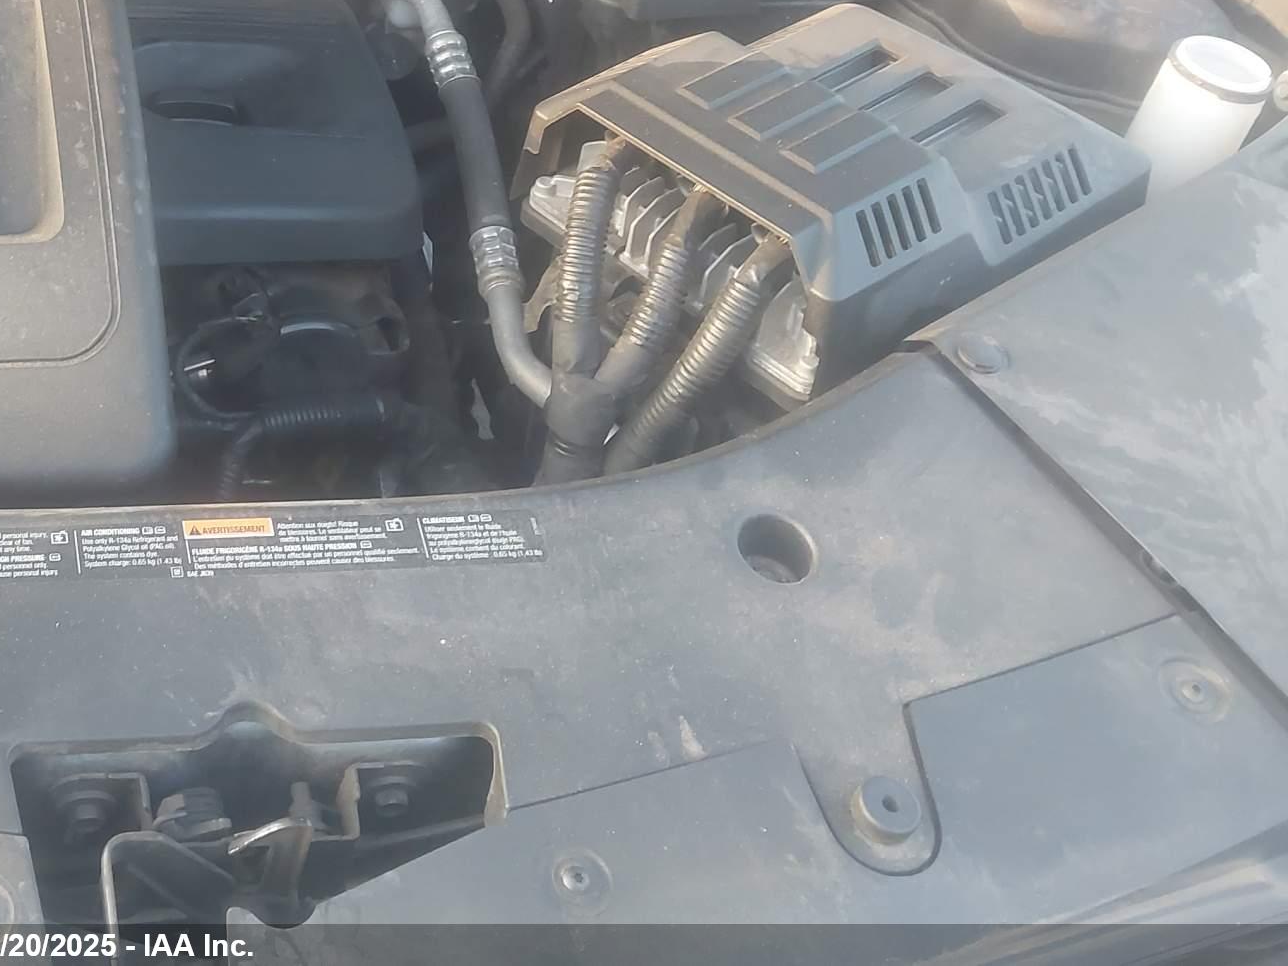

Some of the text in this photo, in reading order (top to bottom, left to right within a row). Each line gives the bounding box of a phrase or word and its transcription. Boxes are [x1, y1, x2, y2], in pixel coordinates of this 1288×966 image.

[93, 528, 140, 536] CONDITIONING
[202, 525, 265, 534] AVERTISSEMENT
[324, 542, 357, 550] PRESSION
[11, 554, 45, 562] PRESSURE
[2, 563, 33, 571] personnel
[13, 570, 40, 578] personal
